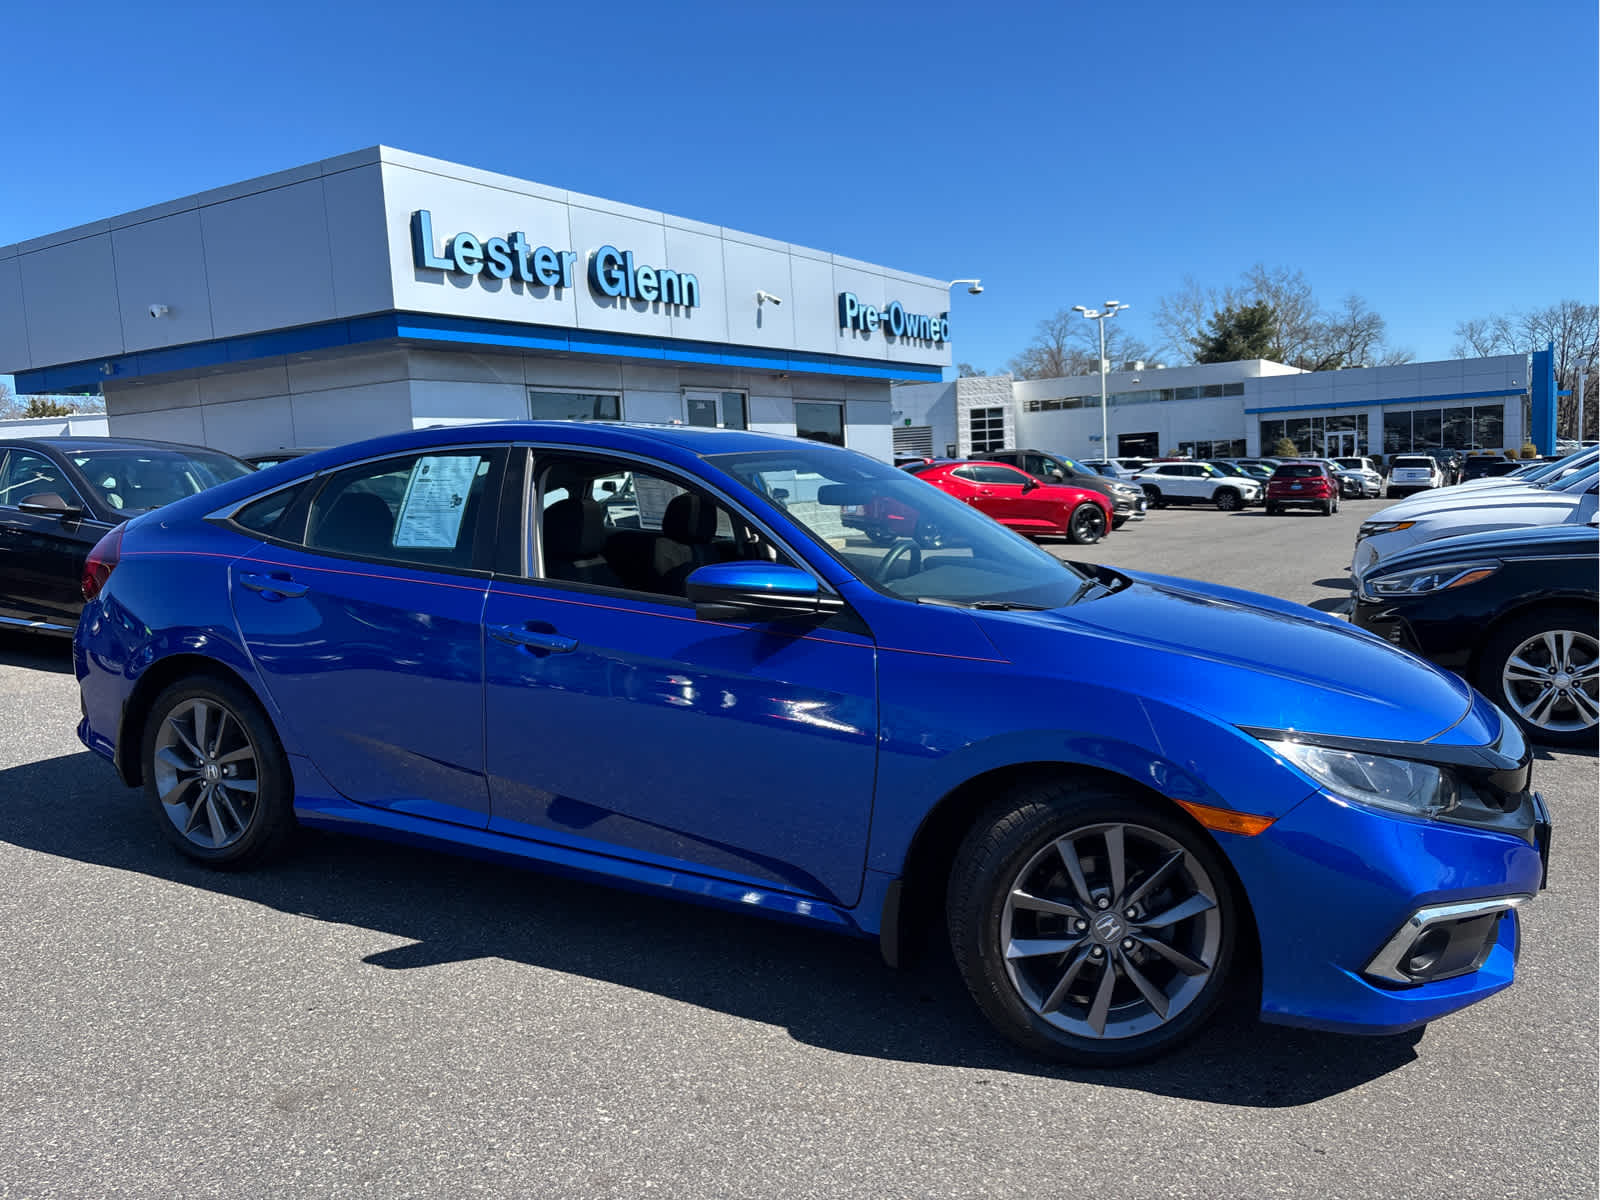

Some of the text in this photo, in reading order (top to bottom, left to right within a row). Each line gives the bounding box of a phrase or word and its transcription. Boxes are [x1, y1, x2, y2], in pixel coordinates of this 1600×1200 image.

[410, 209, 700, 308] Lester Glenn
[838, 291, 951, 342] Pre-Owned
